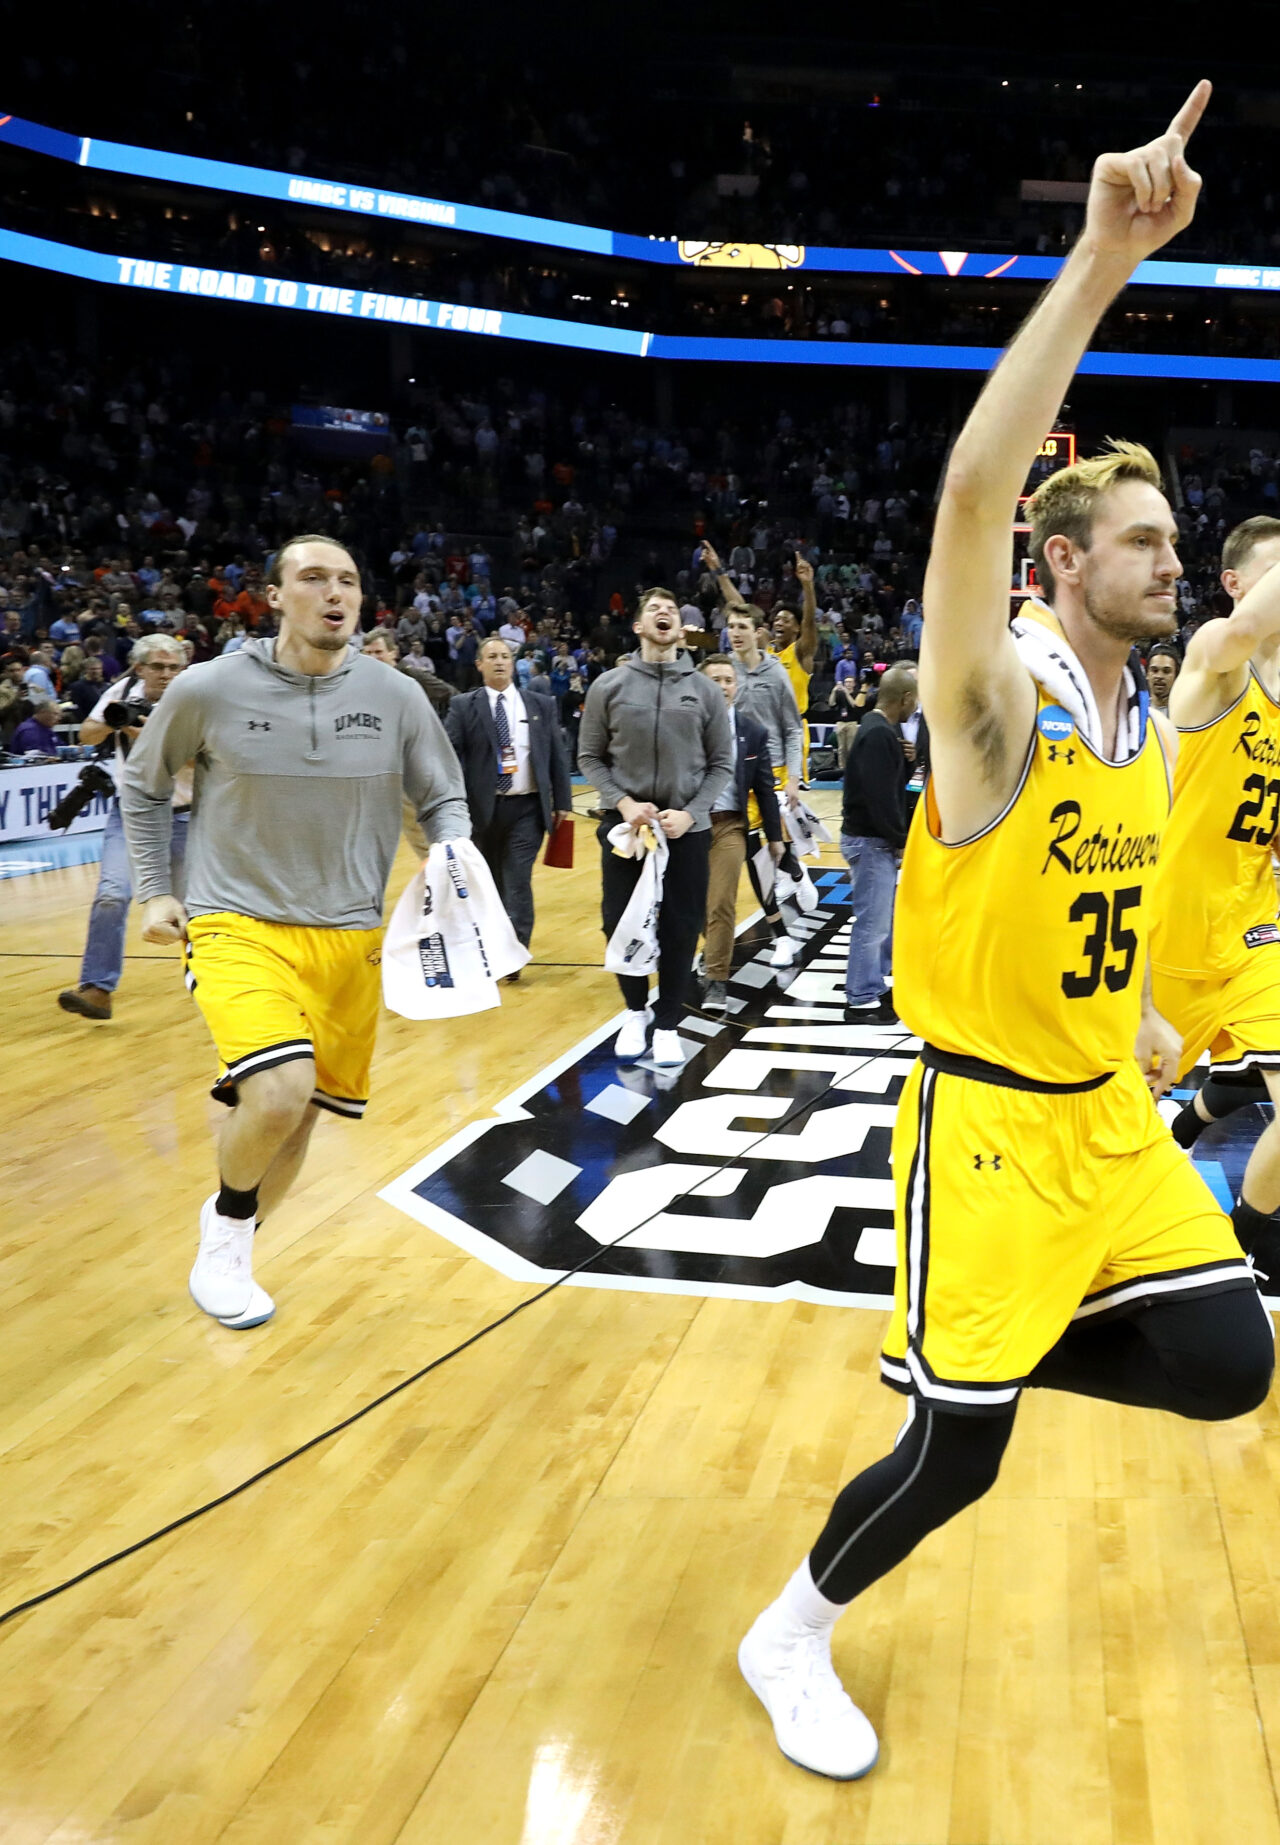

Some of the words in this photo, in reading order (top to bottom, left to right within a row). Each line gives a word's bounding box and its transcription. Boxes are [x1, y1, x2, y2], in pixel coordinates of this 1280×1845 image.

[288, 179, 347, 206] UMBC
[350, 189, 375, 211] VS
[378, 194, 456, 225] VIRGINIA
[117, 257, 173, 289] THE
[179, 266, 256, 300] ROAD
[263, 278, 298, 306] TO
[305, 284, 355, 314] THE
[360, 292, 431, 325] FINAL
[437, 303, 502, 335] FOUR
[334, 712, 382, 732] UMBC
[1041, 719, 1074, 732] NCAA
[1061, 885, 1142, 999] 35
